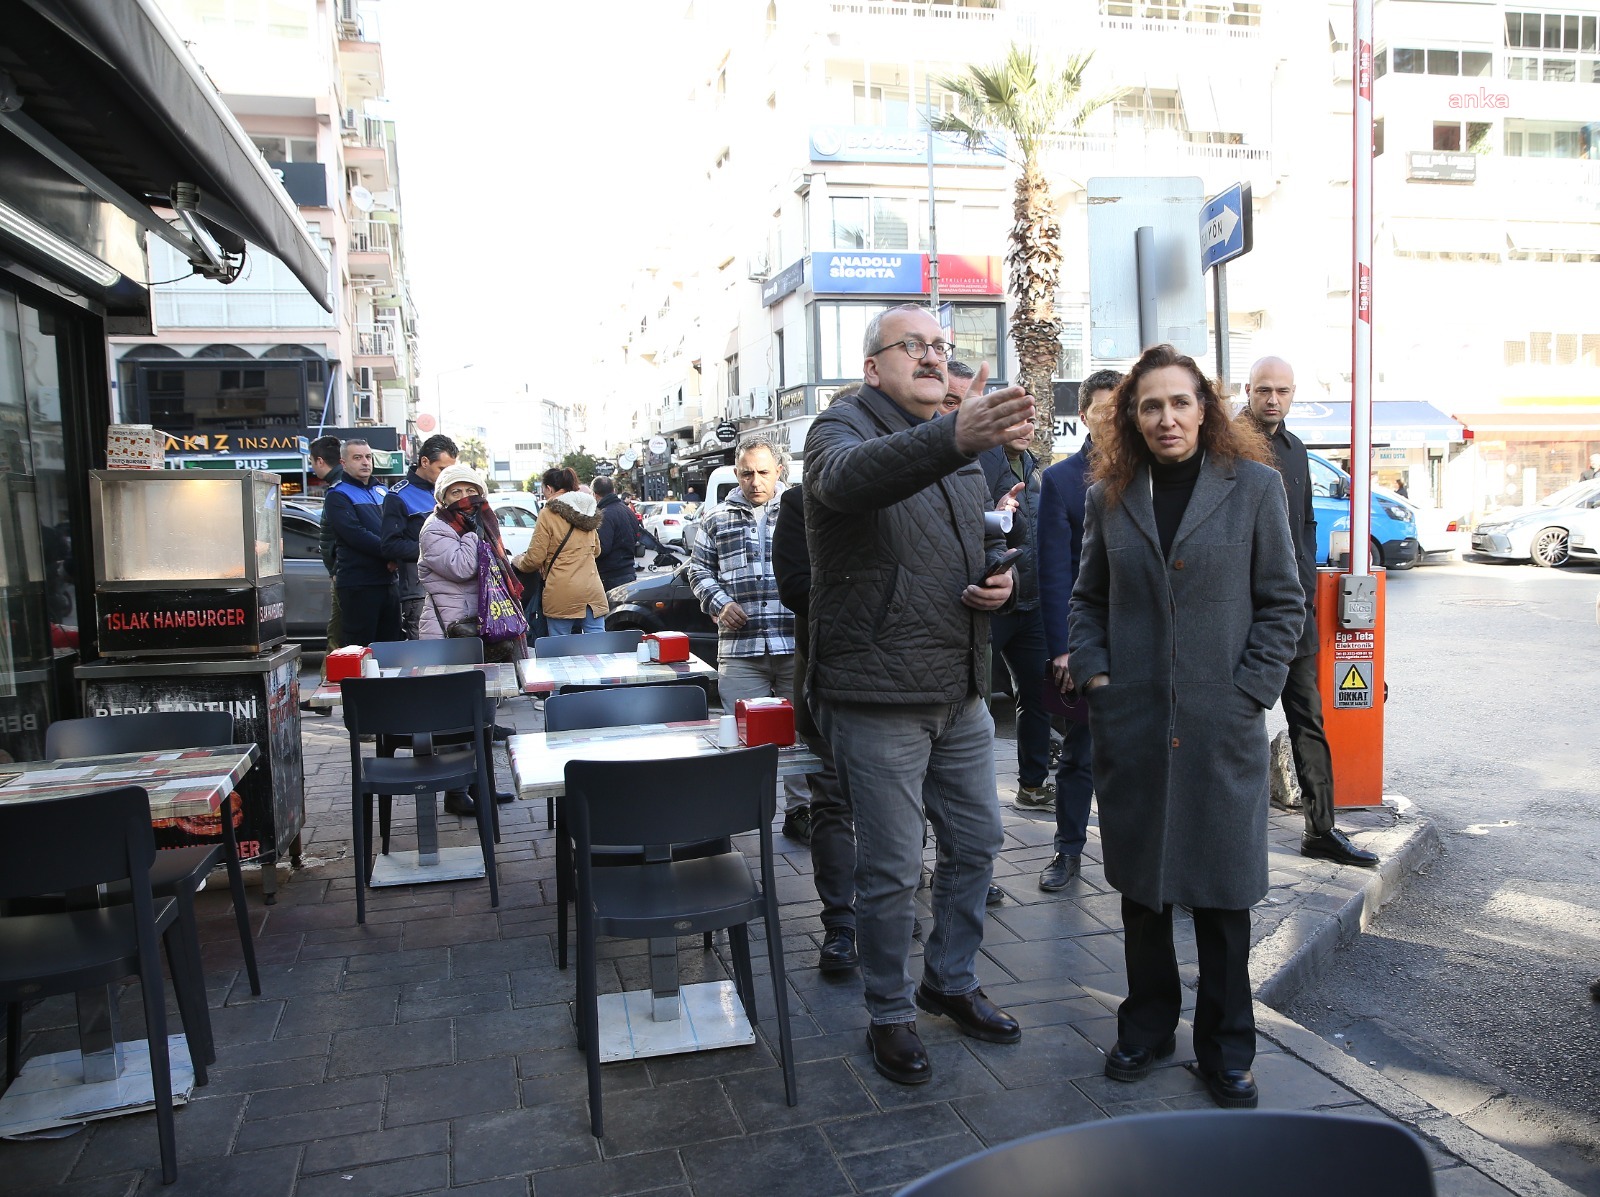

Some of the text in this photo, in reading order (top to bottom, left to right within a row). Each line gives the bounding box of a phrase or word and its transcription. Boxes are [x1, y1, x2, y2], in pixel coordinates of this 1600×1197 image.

[1208, 219, 1223, 241] YÖN
[829, 256, 902, 268] ANADOLU
[829, 264, 896, 279] SİGORTA
[235, 459, 269, 470] PLUS
[1349, 603, 1371, 612] Nice
[153, 608, 246, 629] HAMBURGER
[1336, 631, 1374, 642] Ege Teta
